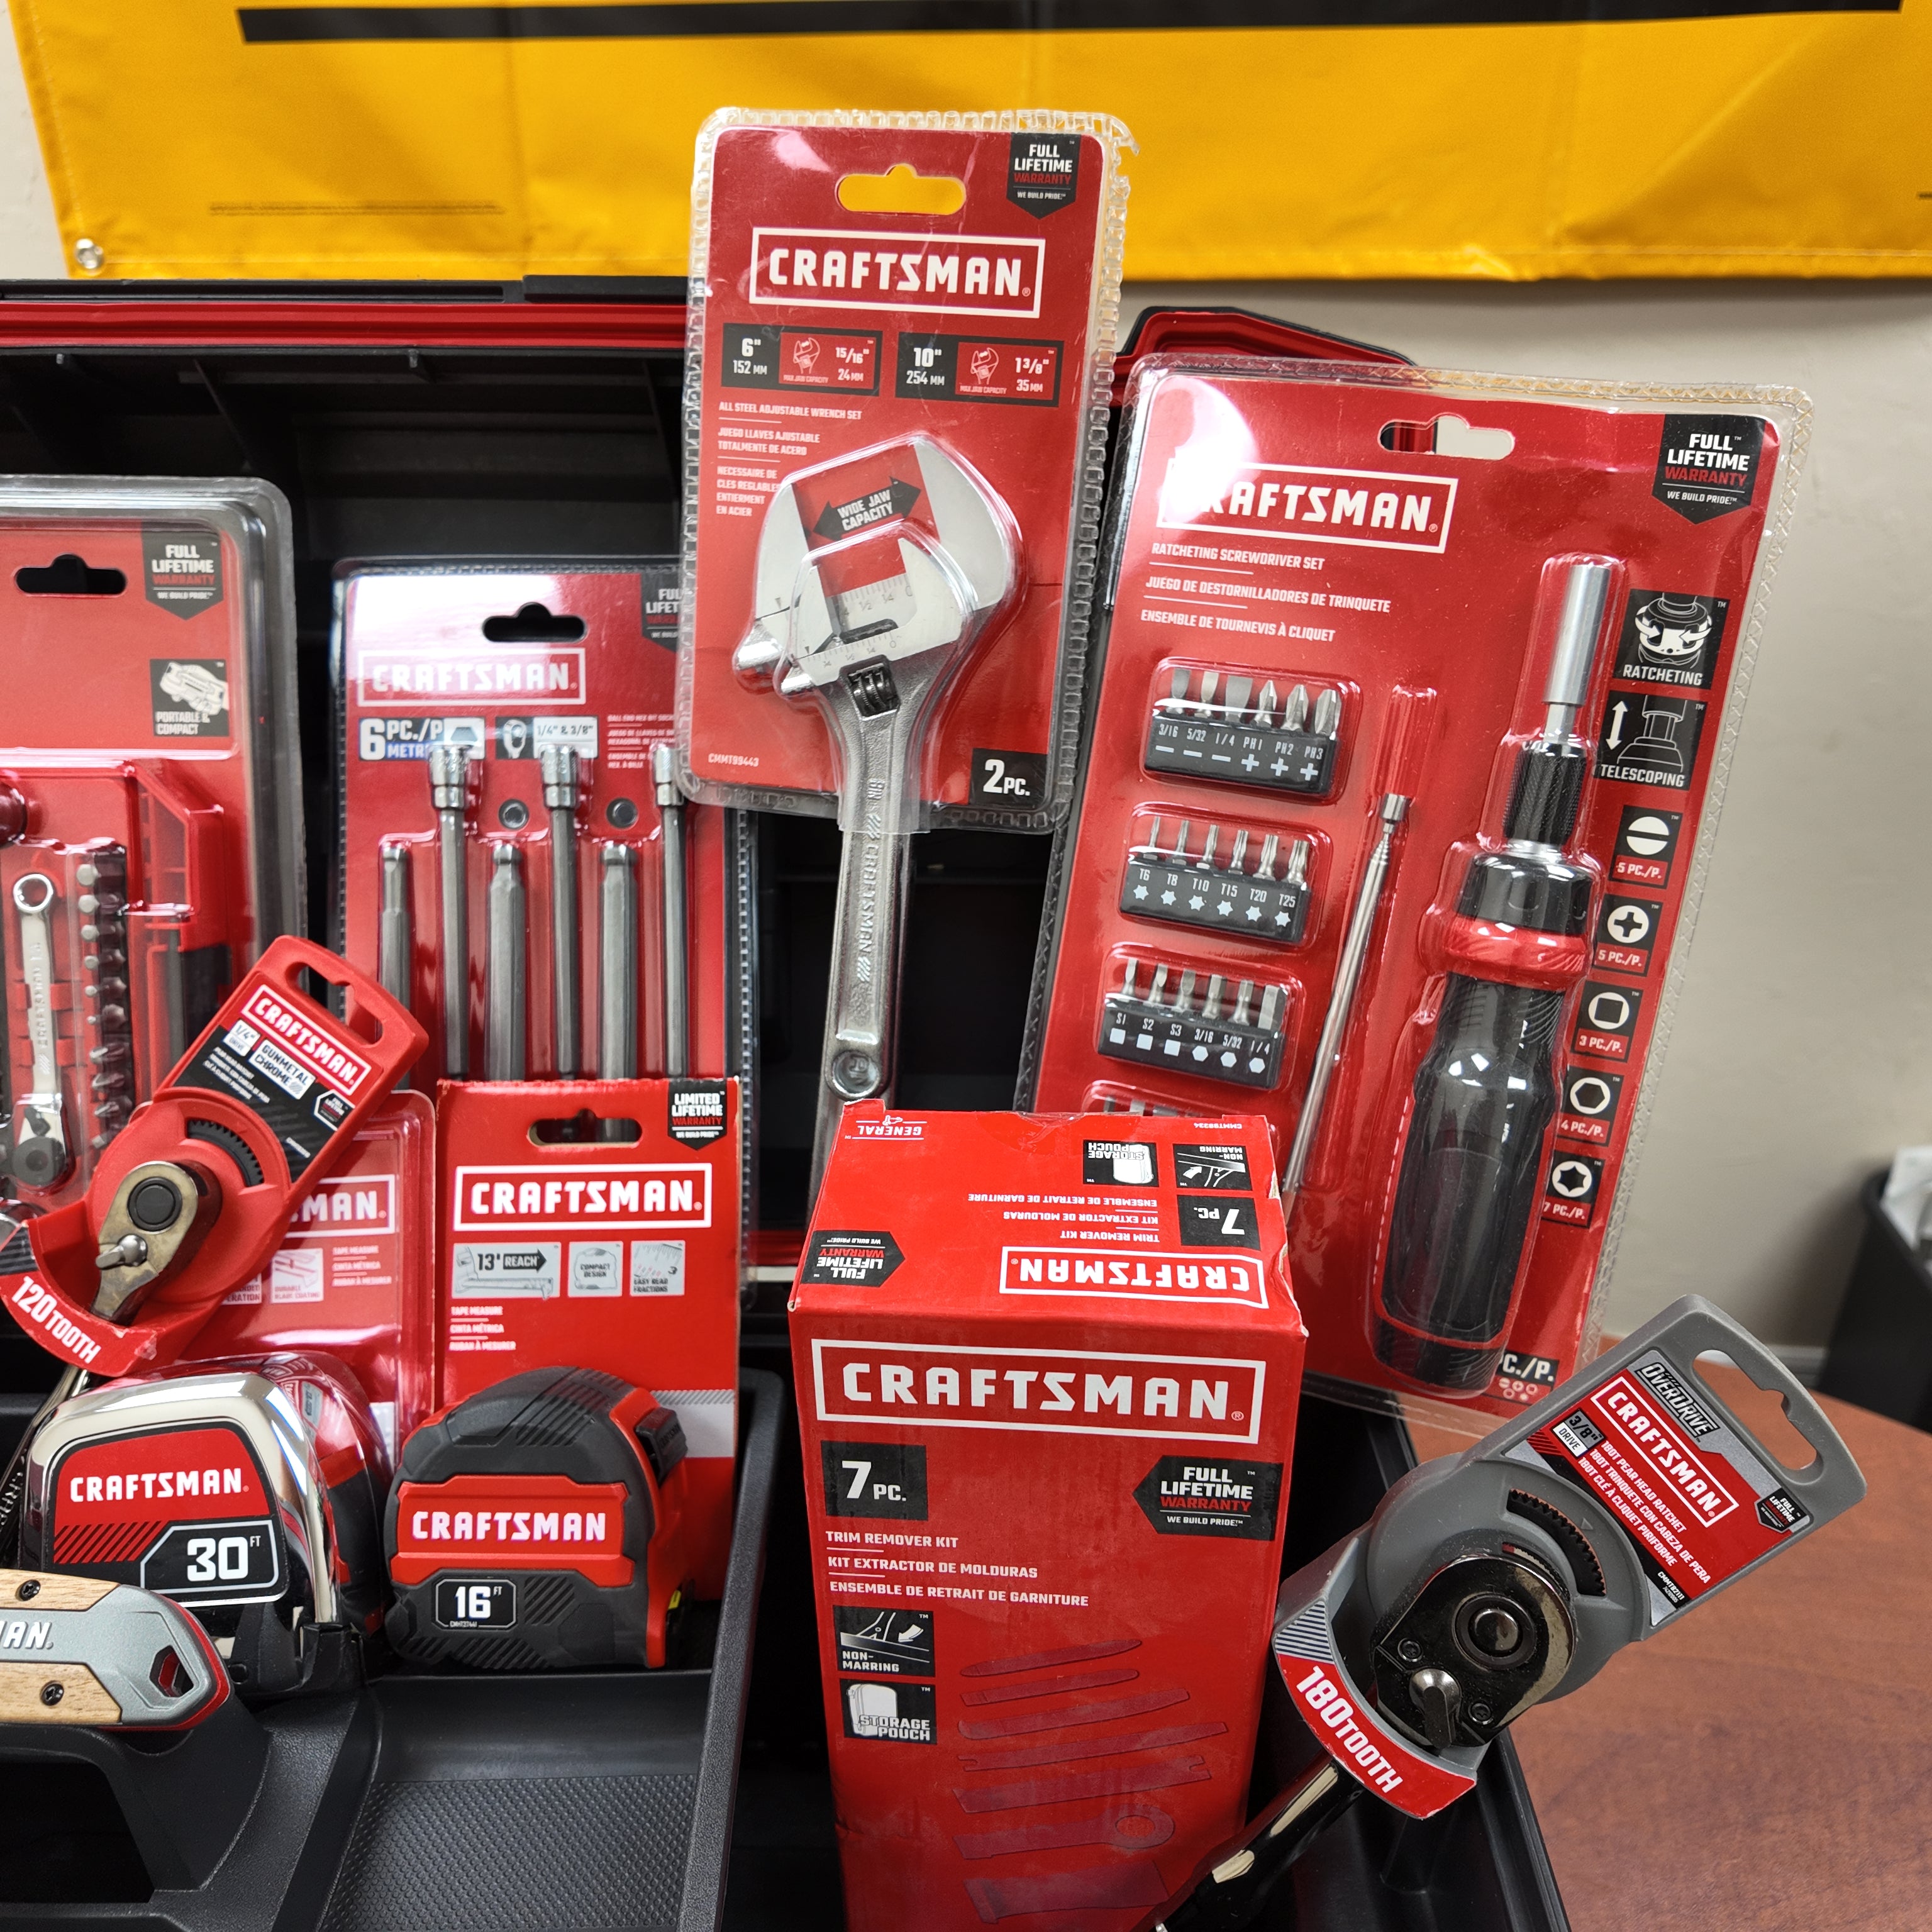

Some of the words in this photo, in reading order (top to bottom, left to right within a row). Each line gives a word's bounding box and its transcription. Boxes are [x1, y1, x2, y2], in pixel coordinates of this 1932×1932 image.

[1029, 144, 1060, 157] FULL
[1014, 158, 1072, 172] LIFETIME
[1014, 173, 1072, 184] WARRANTY
[741, 338, 761, 356] 6"
[914, 348, 941, 367] 10"
[733, 360, 751, 374] 152
[753, 365, 767, 375] MM
[906, 370, 928, 384] 254
[930, 375, 945, 386] MM
[719, 402, 733, 411] ALL
[735, 403, 758, 413] STEEL
[759, 406, 809, 417] ADJUSTABLE
[811, 408, 845, 418] WRENCH
[847, 410, 862, 419] SET
[1689, 433, 1733, 451] FULL
[1667, 449, 1750, 471] LIFETIME
[1665, 466, 1747, 487] WARRANTY
[837, 500, 865, 518] WIDE
[869, 490, 891, 508] JAW
[1667, 491, 1680, 499] WE
[1682, 492, 1704, 502] BUILD
[841, 502, 893, 531] CAPACITY
[165, 545, 200, 558] FULL
[1152, 543, 1218, 562] RATCHETING
[1219, 549, 1301, 568] SCREWDRIVER
[1303, 558, 1324, 571] SET
[152, 559, 214, 573] LIFETIME
[1146, 577, 1181, 592] JUEGO
[1183, 581, 1197, 593] DE
[1199, 582, 1309, 605] DESTORNILLADORES
[1311, 594, 1326, 606] DE
[1328, 596, 1391, 613] TRINQUETE
[1141, 610, 1196, 626] ENSEMBLE
[1199, 616, 1213, 629] DE
[1216, 618, 1276, 637] TOURNEVIS
[1278, 622, 1286, 637] À
[1288, 626, 1336, 643] CLIQUET
[1623, 664, 1703, 686] RATCHETING
[155, 711, 201, 723] PORTABLE
[155, 723, 199, 735] COMPACT
[360, 718, 386, 760] 6
[1158, 726, 1178, 738] 3/16
[1187, 728, 1206, 742] 5/32
[1243, 736, 1262, 751] PH1
[1275, 741, 1292, 755] PH2
[1304, 746, 1323, 760] PH3
[982, 758, 1004, 794] 2
[1003, 777, 1030, 796] PC.
[1601, 764, 1684, 787] TELESCOPING
[1618, 862, 1626, 874] 5
[1140, 869, 1150, 880] T6
[1167, 874, 1178, 886] T8
[1192, 878, 1209, 892] T10
[1221, 883, 1238, 897] T15
[1250, 888, 1267, 902] T20
[1279, 894, 1296, 908] T25
[1598, 950, 1606, 961] 5
[1116, 1013, 1126, 1024] S1
[1143, 1018, 1153, 1031] S2
[1170, 1024, 1182, 1036] S3
[1223, 1034, 1243, 1049] 5/32
[1579, 1036, 1587, 1046] 3
[255, 1053, 290, 1086] CHROME
[262, 1045, 309, 1085] GUNMETAL
[674, 1093, 719, 1105] LIMITED
[672, 1104, 723, 1116] LIFETIME
[672, 1116, 722, 1125] WARRANTY
[1560, 1119, 1568, 1130] 4
[857, 1125, 922, 1136] GENERAL
[969, 1194, 1024, 1202] GARNITURE
[1027, 1194, 1040, 1202] DE
[1043, 1196, 1084, 1205] RETRAIT
[1087, 1197, 1101, 1205] DE
[1104, 1197, 1157, 1207] ENSEMBLE
[1004, 1211, 1060, 1221] MOLDURAS
[1079, 1214, 1139, 1223] EXTRACTOR
[1141, 1216, 1158, 1224] KIT
[1194, 1208, 1220, 1219] PC.
[1221, 1209, 1245, 1235] 7
[1060, 1231, 1077, 1239] KIT
[1079, 1231, 1131, 1241] REMOVER
[1133, 1233, 1160, 1242] TRIM
[505, 1255, 538, 1267] REACH
[819, 1248, 884, 1258] WARRANTY
[817, 1257, 883, 1269] LIFETIME
[833, 1268, 866, 1279] FULL
[1641, 1362, 1713, 1436] OVERDRIVE
[1568, 1414, 1598, 1441] 3/8"
[1558, 1428, 1581, 1451] DRIVE
[841, 1460, 872, 1499] 7
[873, 1483, 906, 1502] PC.
[1183, 1466, 1233, 1483] FULL
[1161, 1480, 1253, 1499] LIFETIME
[1601, 1440, 1618, 1460] 180T
[1616, 1458, 1636, 1480] PEAR
[1634, 1478, 1657, 1501] HEAD
[1653, 1498, 1687, 1533] RATCHET
[1160, 1496, 1252, 1512] WARRANTY
[1578, 1457, 1595, 1477] 180T
[1594, 1474, 1612, 1491] CLÉ
[1605, 1487, 1616, 1497] À
[1611, 1495, 1642, 1526] CLIQUET
[1638, 1524, 1677, 1566] PIRIFORME
[1590, 1449, 1606, 1468] 180T
[1605, 1467, 1644, 1507] TRINQUETE
[1640, 1504, 1658, 1523] CON
[1653, 1520, 1684, 1552] CABEZA
[1679, 1550, 1694, 1563] DE
[1689, 1560, 1711, 1584] PERA
[412, 1511, 606, 1540] CRAFTSMAN
[826, 1531, 860, 1543] TRIM
[865, 1533, 932, 1547] REMOVER
[936, 1536, 958, 1548] KIT
[187, 1537, 248, 1581] 30
[250, 1535, 260, 1547] FT
[828, 1557, 850, 1568] KIT
[854, 1558, 934, 1572] EXTRACTOR
[939, 1562, 957, 1573] DE
[960, 1563, 1038, 1579] MOLDURAS
[830, 1581, 902, 1596] ENSEMBLE
[906, 1585, 923, 1596] DE
[928, 1587, 984, 1600] RETRAIT
[989, 1591, 1006, 1601] DE
[1010, 1592, 1089, 1606] GARNITURE
[455, 1586, 491, 1618] 16
[493, 1586, 502, 1595] FT
[842, 1651, 874, 1661] NON-
[843, 1661, 899, 1672] MARRING
[860, 1714, 930, 1730] STORAGE
[879, 1727, 930, 1741] POUCH
